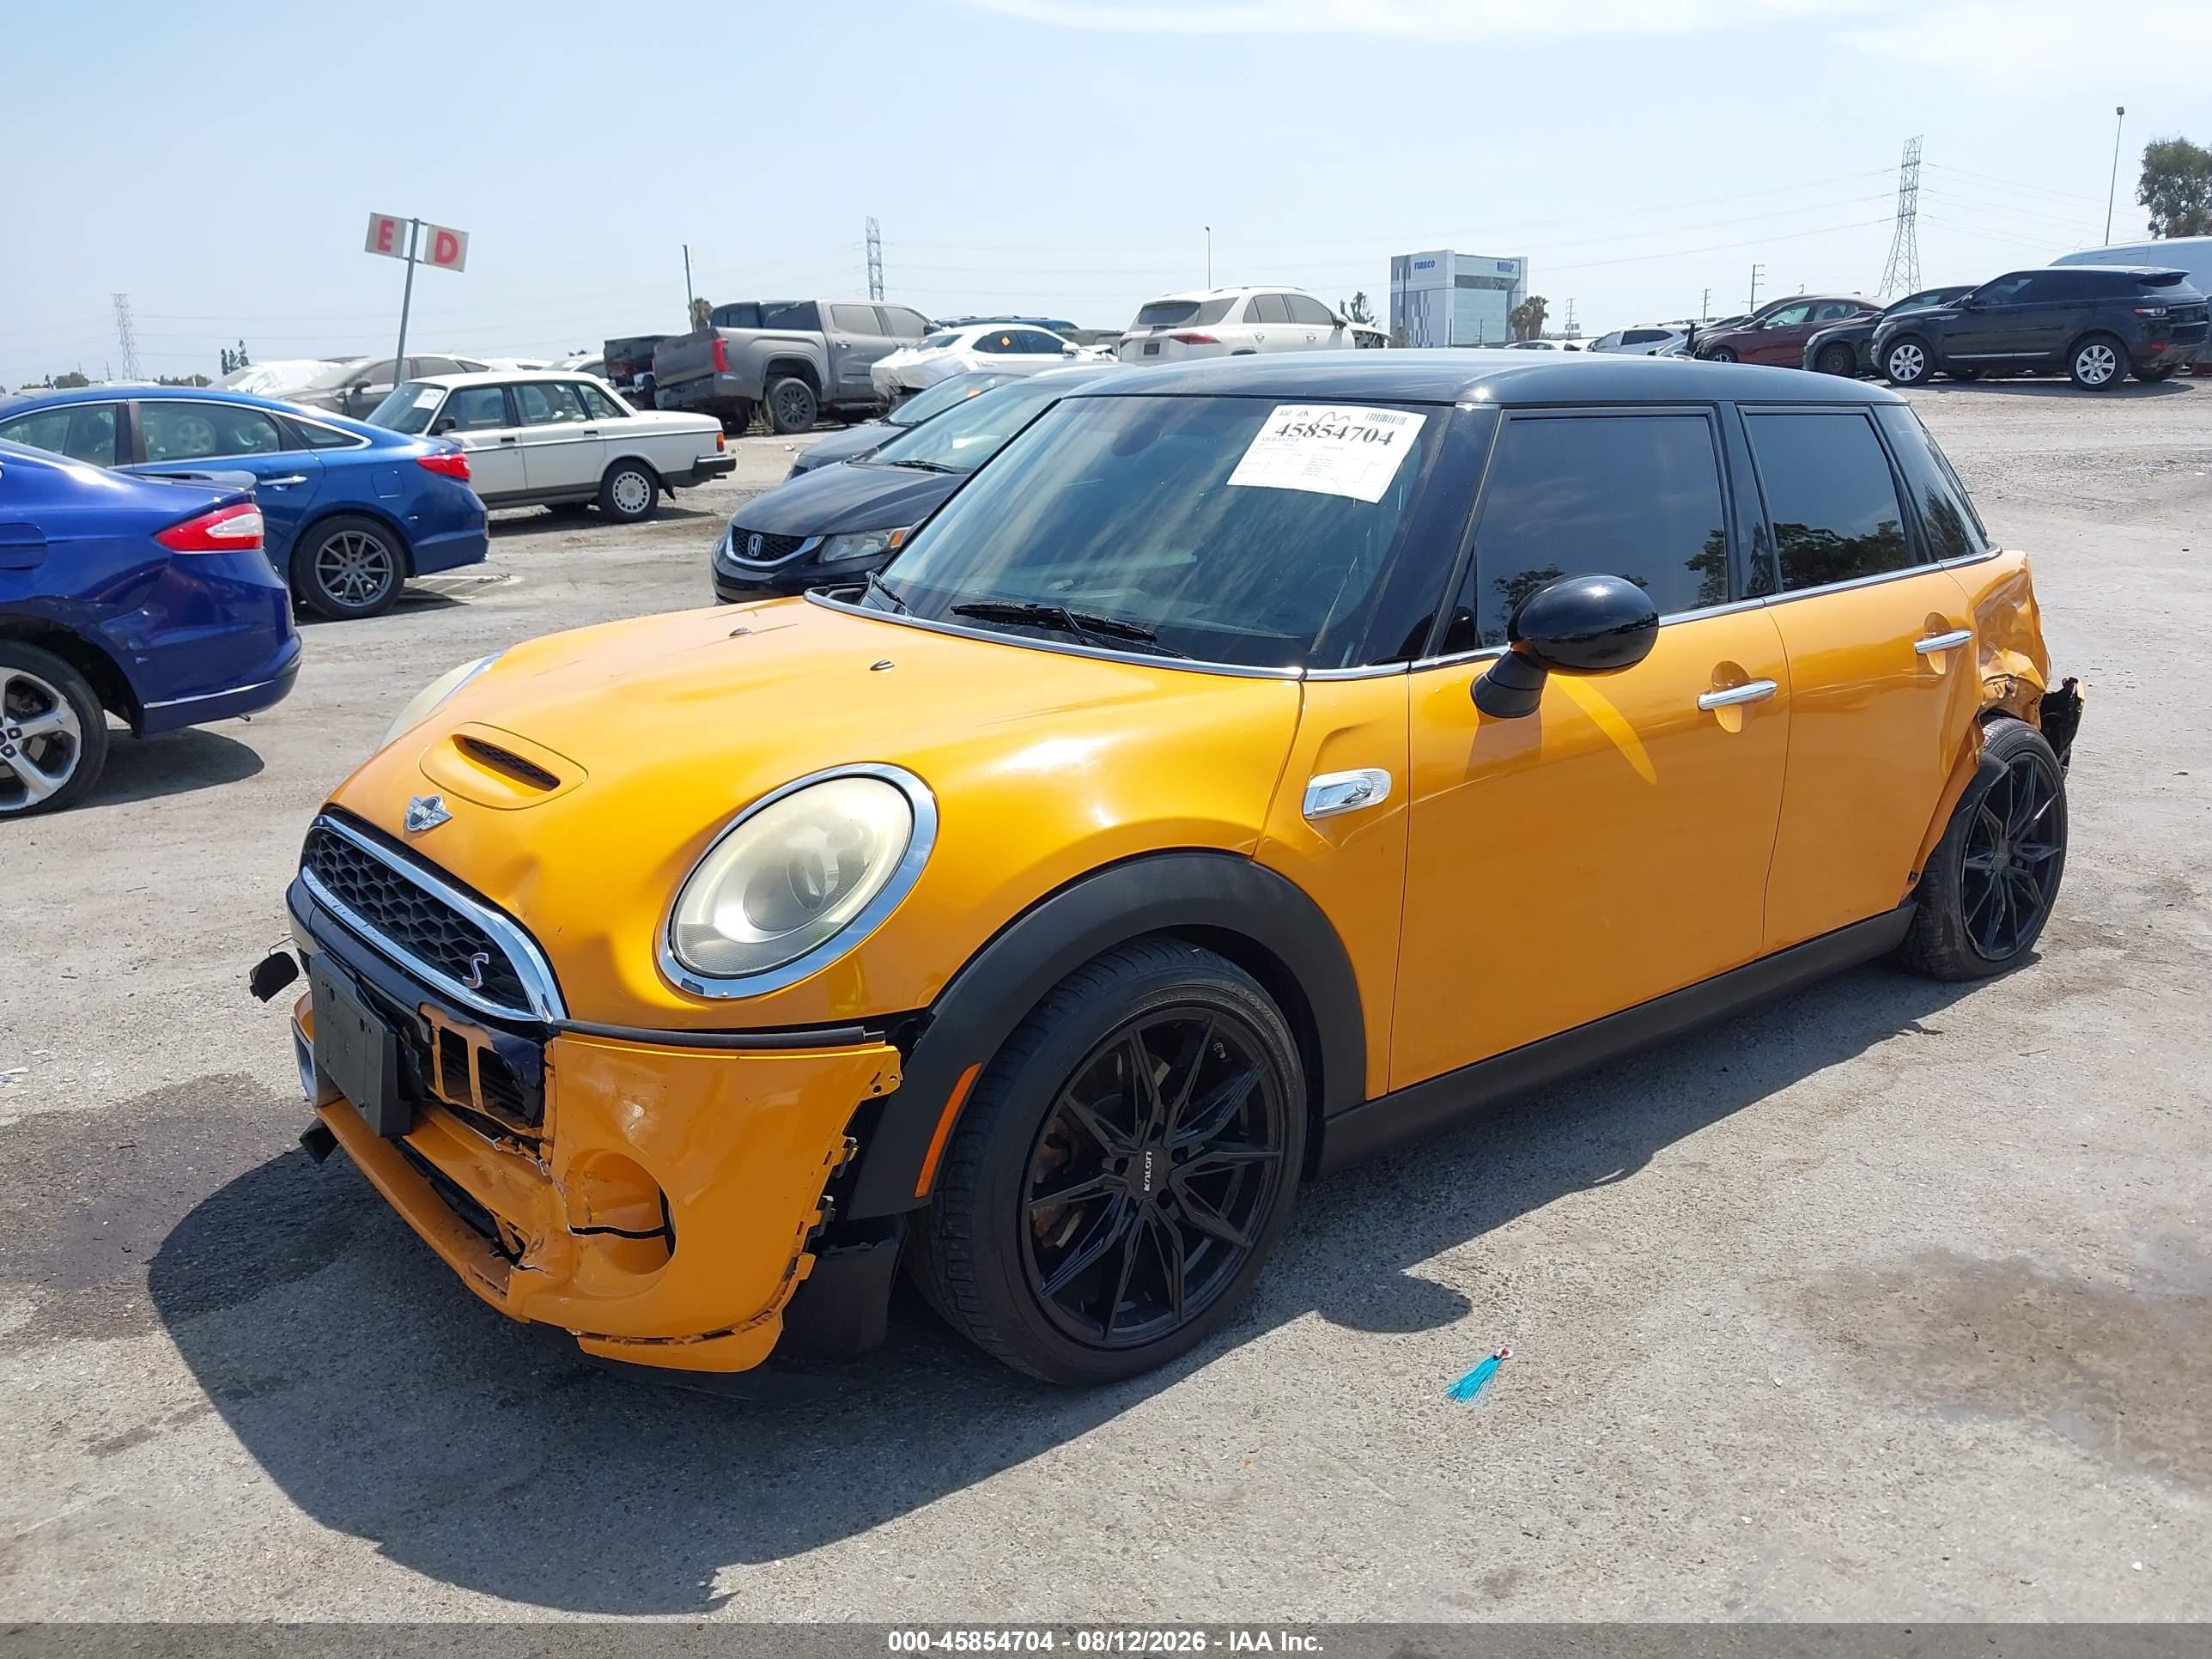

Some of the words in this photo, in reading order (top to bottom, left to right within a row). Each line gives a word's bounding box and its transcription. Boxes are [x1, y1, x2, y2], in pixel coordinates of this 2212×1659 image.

[378, 219, 394, 252] E
[434, 232, 458, 264] D
[1275, 423, 1395, 445] 45854704
